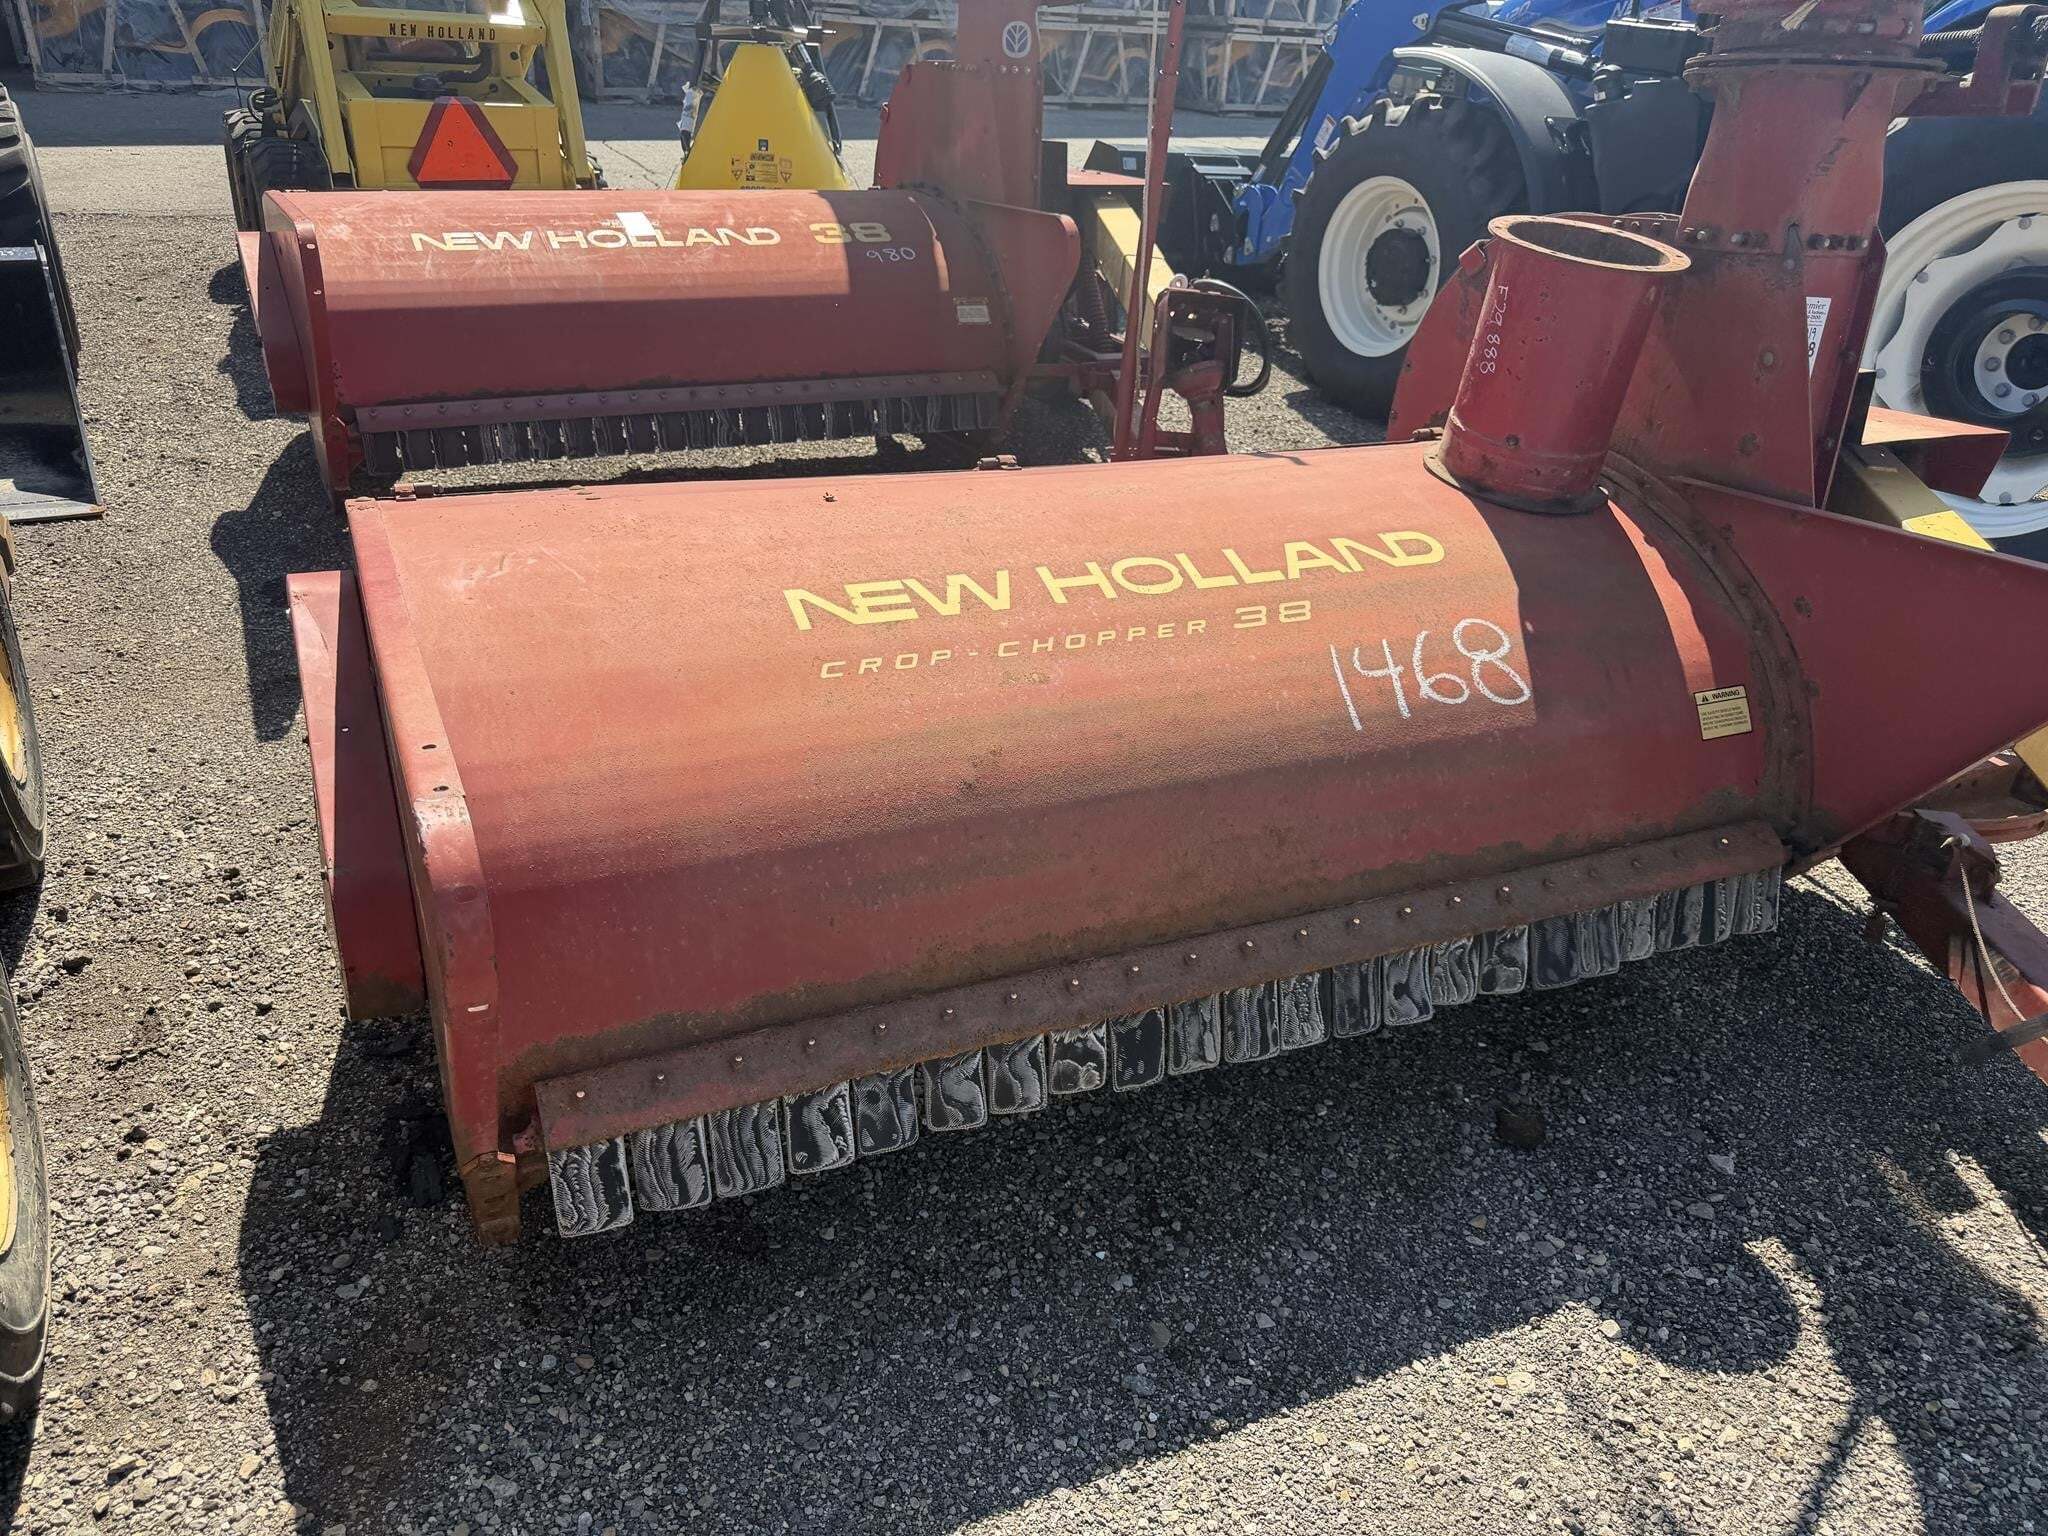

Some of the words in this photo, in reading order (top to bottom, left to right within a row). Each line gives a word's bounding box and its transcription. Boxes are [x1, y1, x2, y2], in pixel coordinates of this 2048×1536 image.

[389, 23, 417, 37] NEW
[427, 25, 496, 41] HOLLAND
[410, 231, 533, 251] NEW
[547, 228, 781, 250] HOLLAND
[809, 222, 893, 244] 38
[866, 247, 916, 263] 980
[783, 570, 1012, 631] NEW
[1036, 530, 1446, 604] HOLLAND
[1233, 600, 1312, 629] 38
[1329, 618, 1533, 731] 1468
[1712, 690, 1740, 700] WARNING
